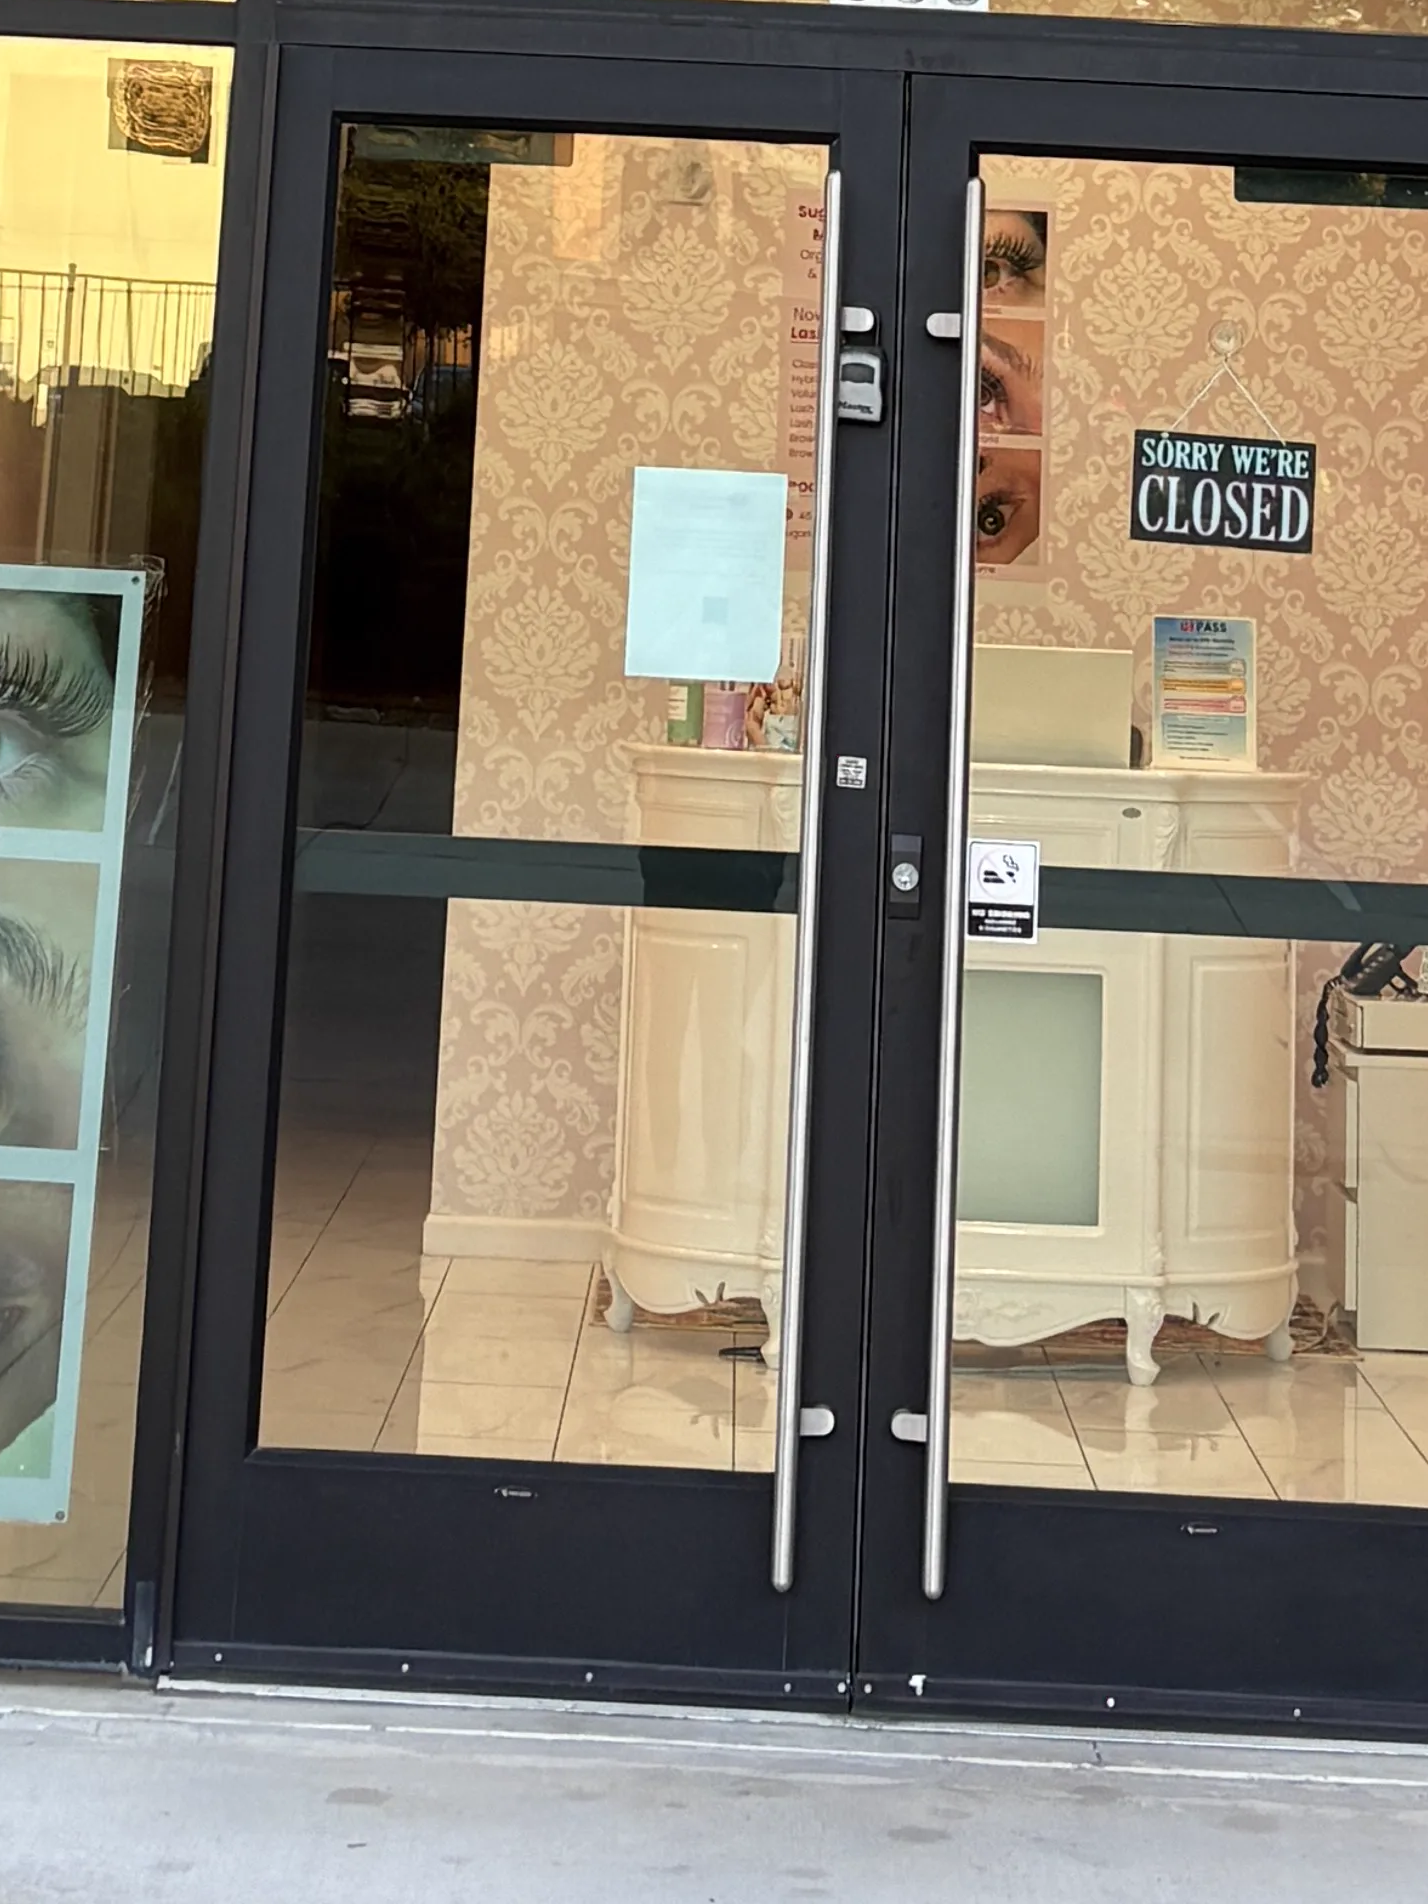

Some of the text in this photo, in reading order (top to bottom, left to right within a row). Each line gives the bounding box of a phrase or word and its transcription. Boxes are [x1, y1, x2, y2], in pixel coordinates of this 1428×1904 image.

[1140, 432, 1311, 481] SORRY WE'RE
[1137, 475, 1312, 545] CLOSED
